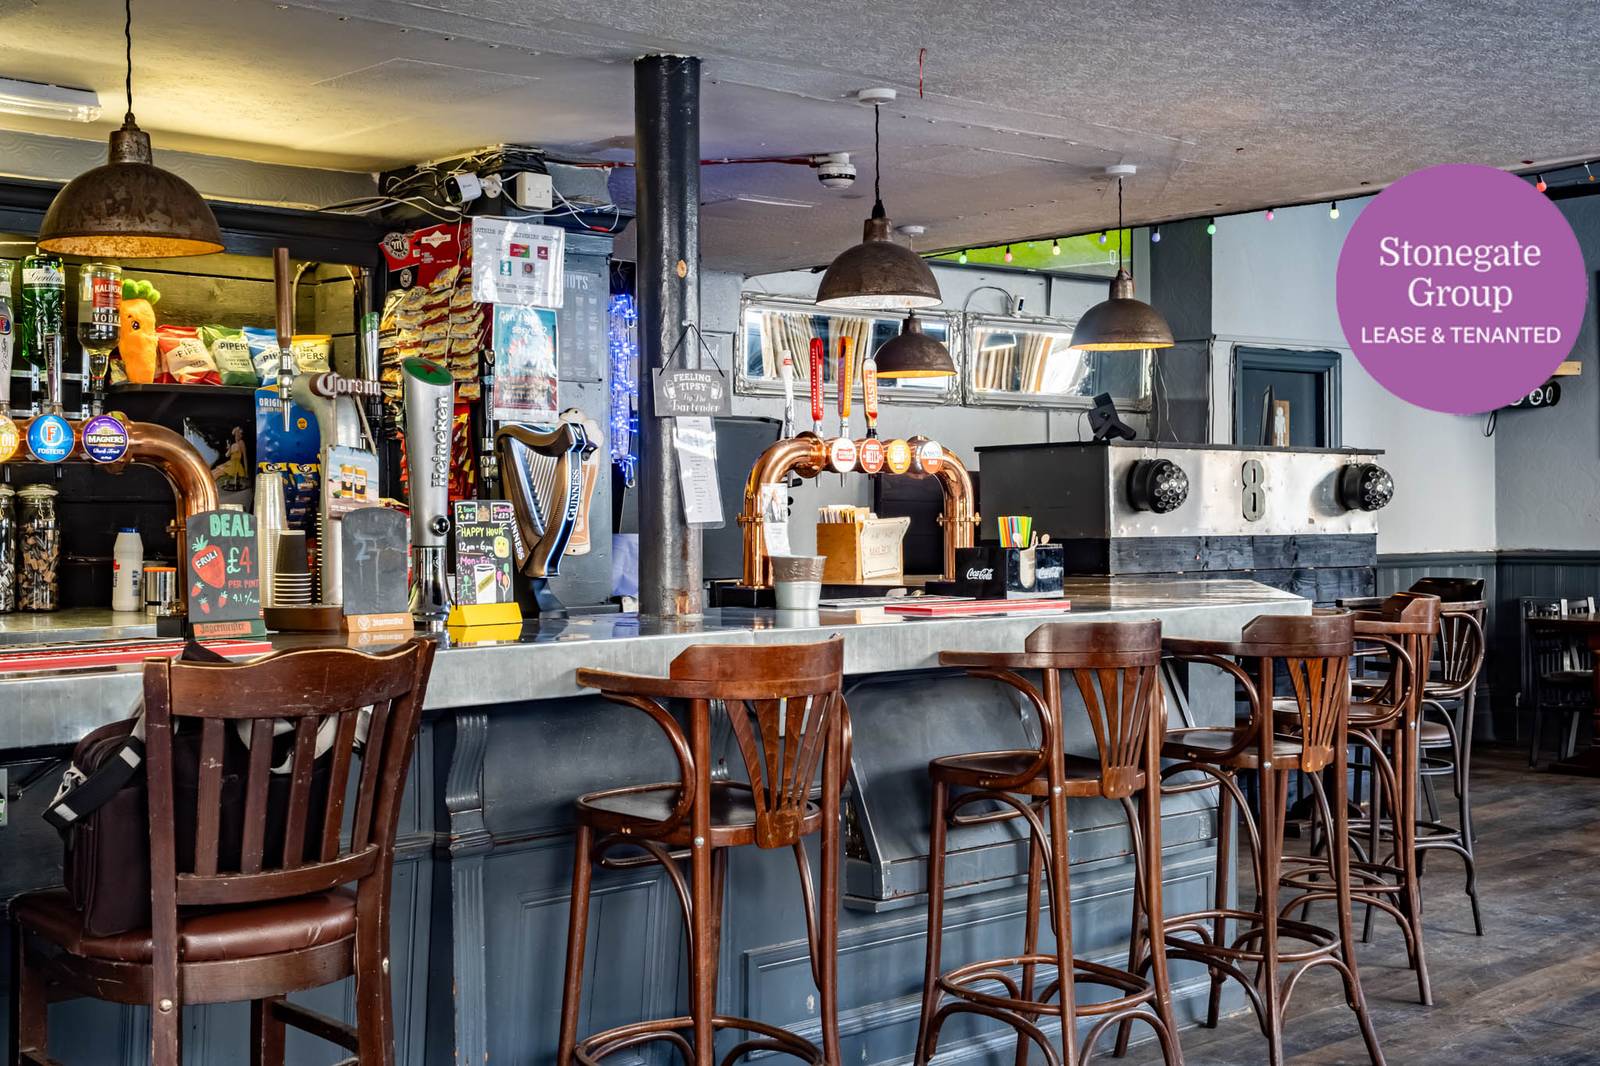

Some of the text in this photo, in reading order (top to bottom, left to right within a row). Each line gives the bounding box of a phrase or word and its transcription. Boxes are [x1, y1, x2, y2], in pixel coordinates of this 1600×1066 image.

[317, 372, 382, 399] Corona
[673, 373, 712, 383] FEELING
[680, 382, 706, 392] TIPSY
[866, 373, 876, 411] AMSTEL
[47, 426, 56, 441] F
[88, 435, 124, 445] MAGNERS
[431, 396, 449, 488] Heineken
[567, 469, 582, 520] GUINNESS
[1241, 459, 1266, 522] 8
[209, 514, 254, 537] DEAL
[461, 527, 504, 537] HAPPY HOUR
[458, 541, 475, 552] 12pm
[480, 541, 493, 552] 6pm
[195, 550, 218, 569] FRULI
[226, 546, 253, 574] £4
[228, 579, 259, 590] PER PINT
